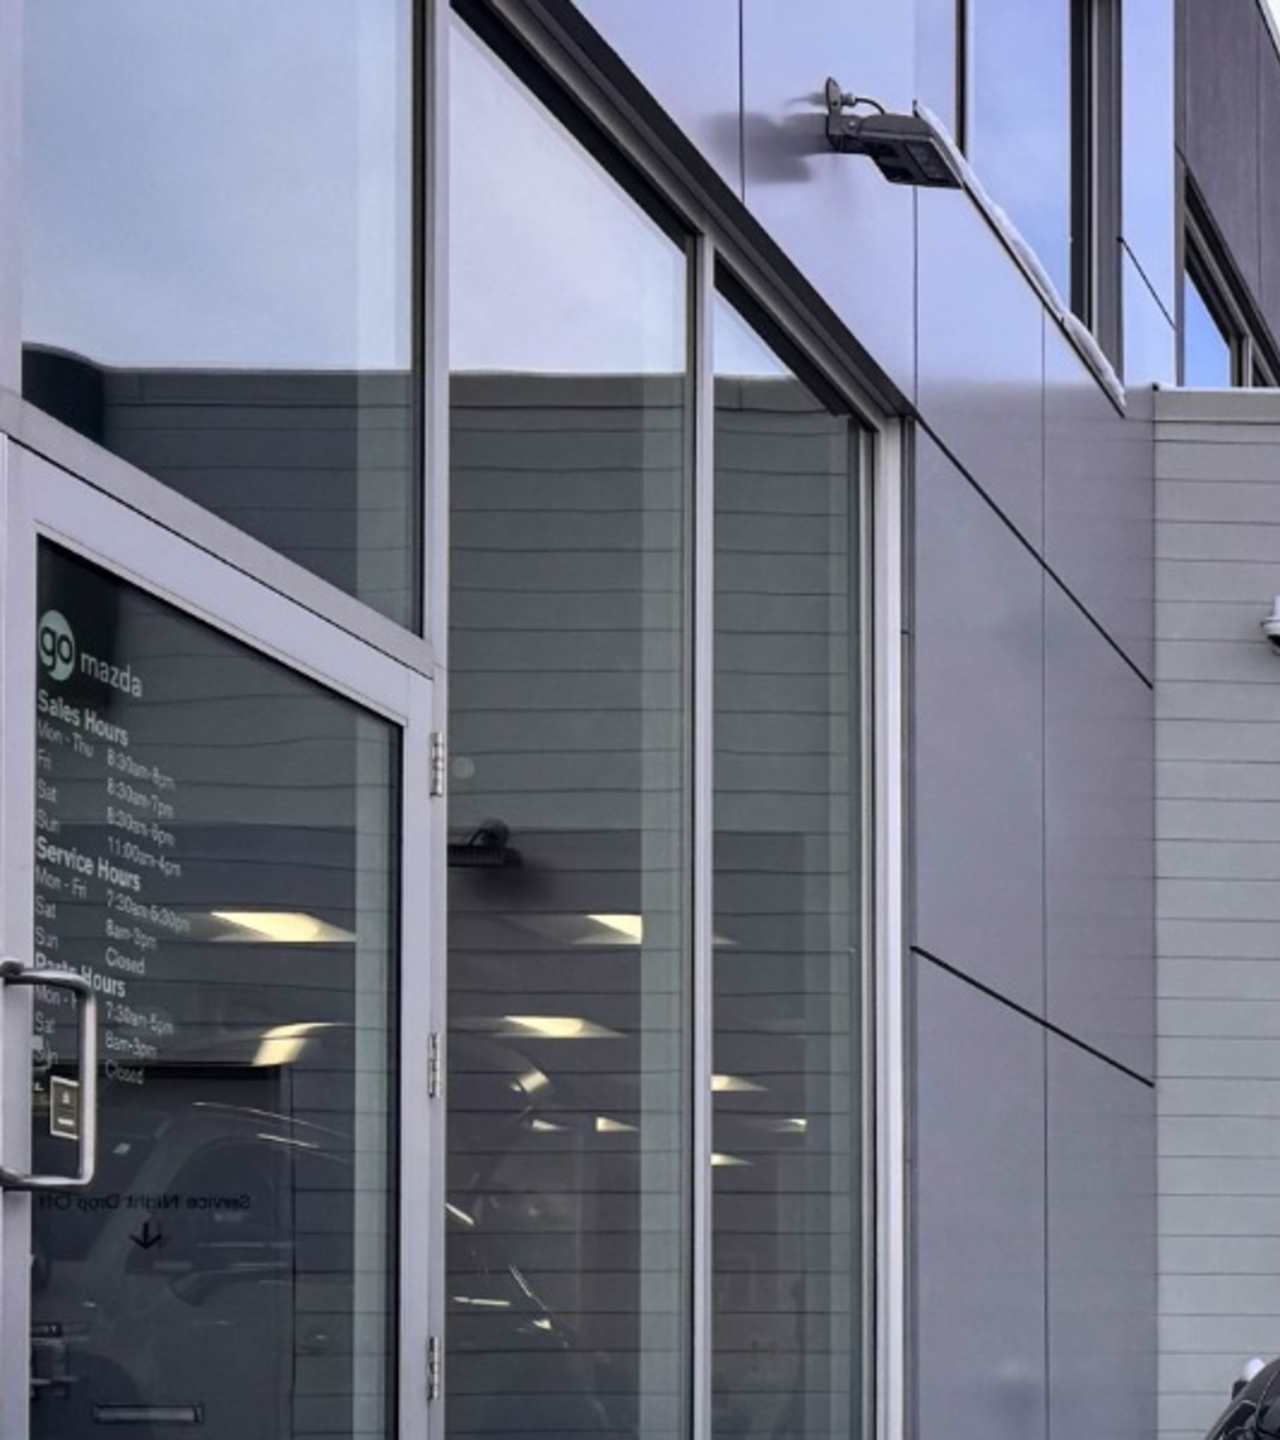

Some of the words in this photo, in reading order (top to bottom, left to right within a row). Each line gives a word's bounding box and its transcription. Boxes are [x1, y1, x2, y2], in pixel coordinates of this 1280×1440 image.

[41, 626, 74, 674] go
[80, 652, 142, 697] mazda
[38, 689, 80, 727] Sales
[84, 708, 129, 746] Hours
[38, 720, 63, 744] Mon
[72, 732, 94, 757] Thu
[38, 778, 57, 802] Sat
[37, 836, 94, 876] Service
[97, 857, 140, 891] Hours
[36, 866, 61, 890] Mon
[71, 878, 87, 898] Fri
[35, 896, 56, 919] Sat
[105, 946, 145, 975] Closed
[80, 965, 126, 997] Hours
